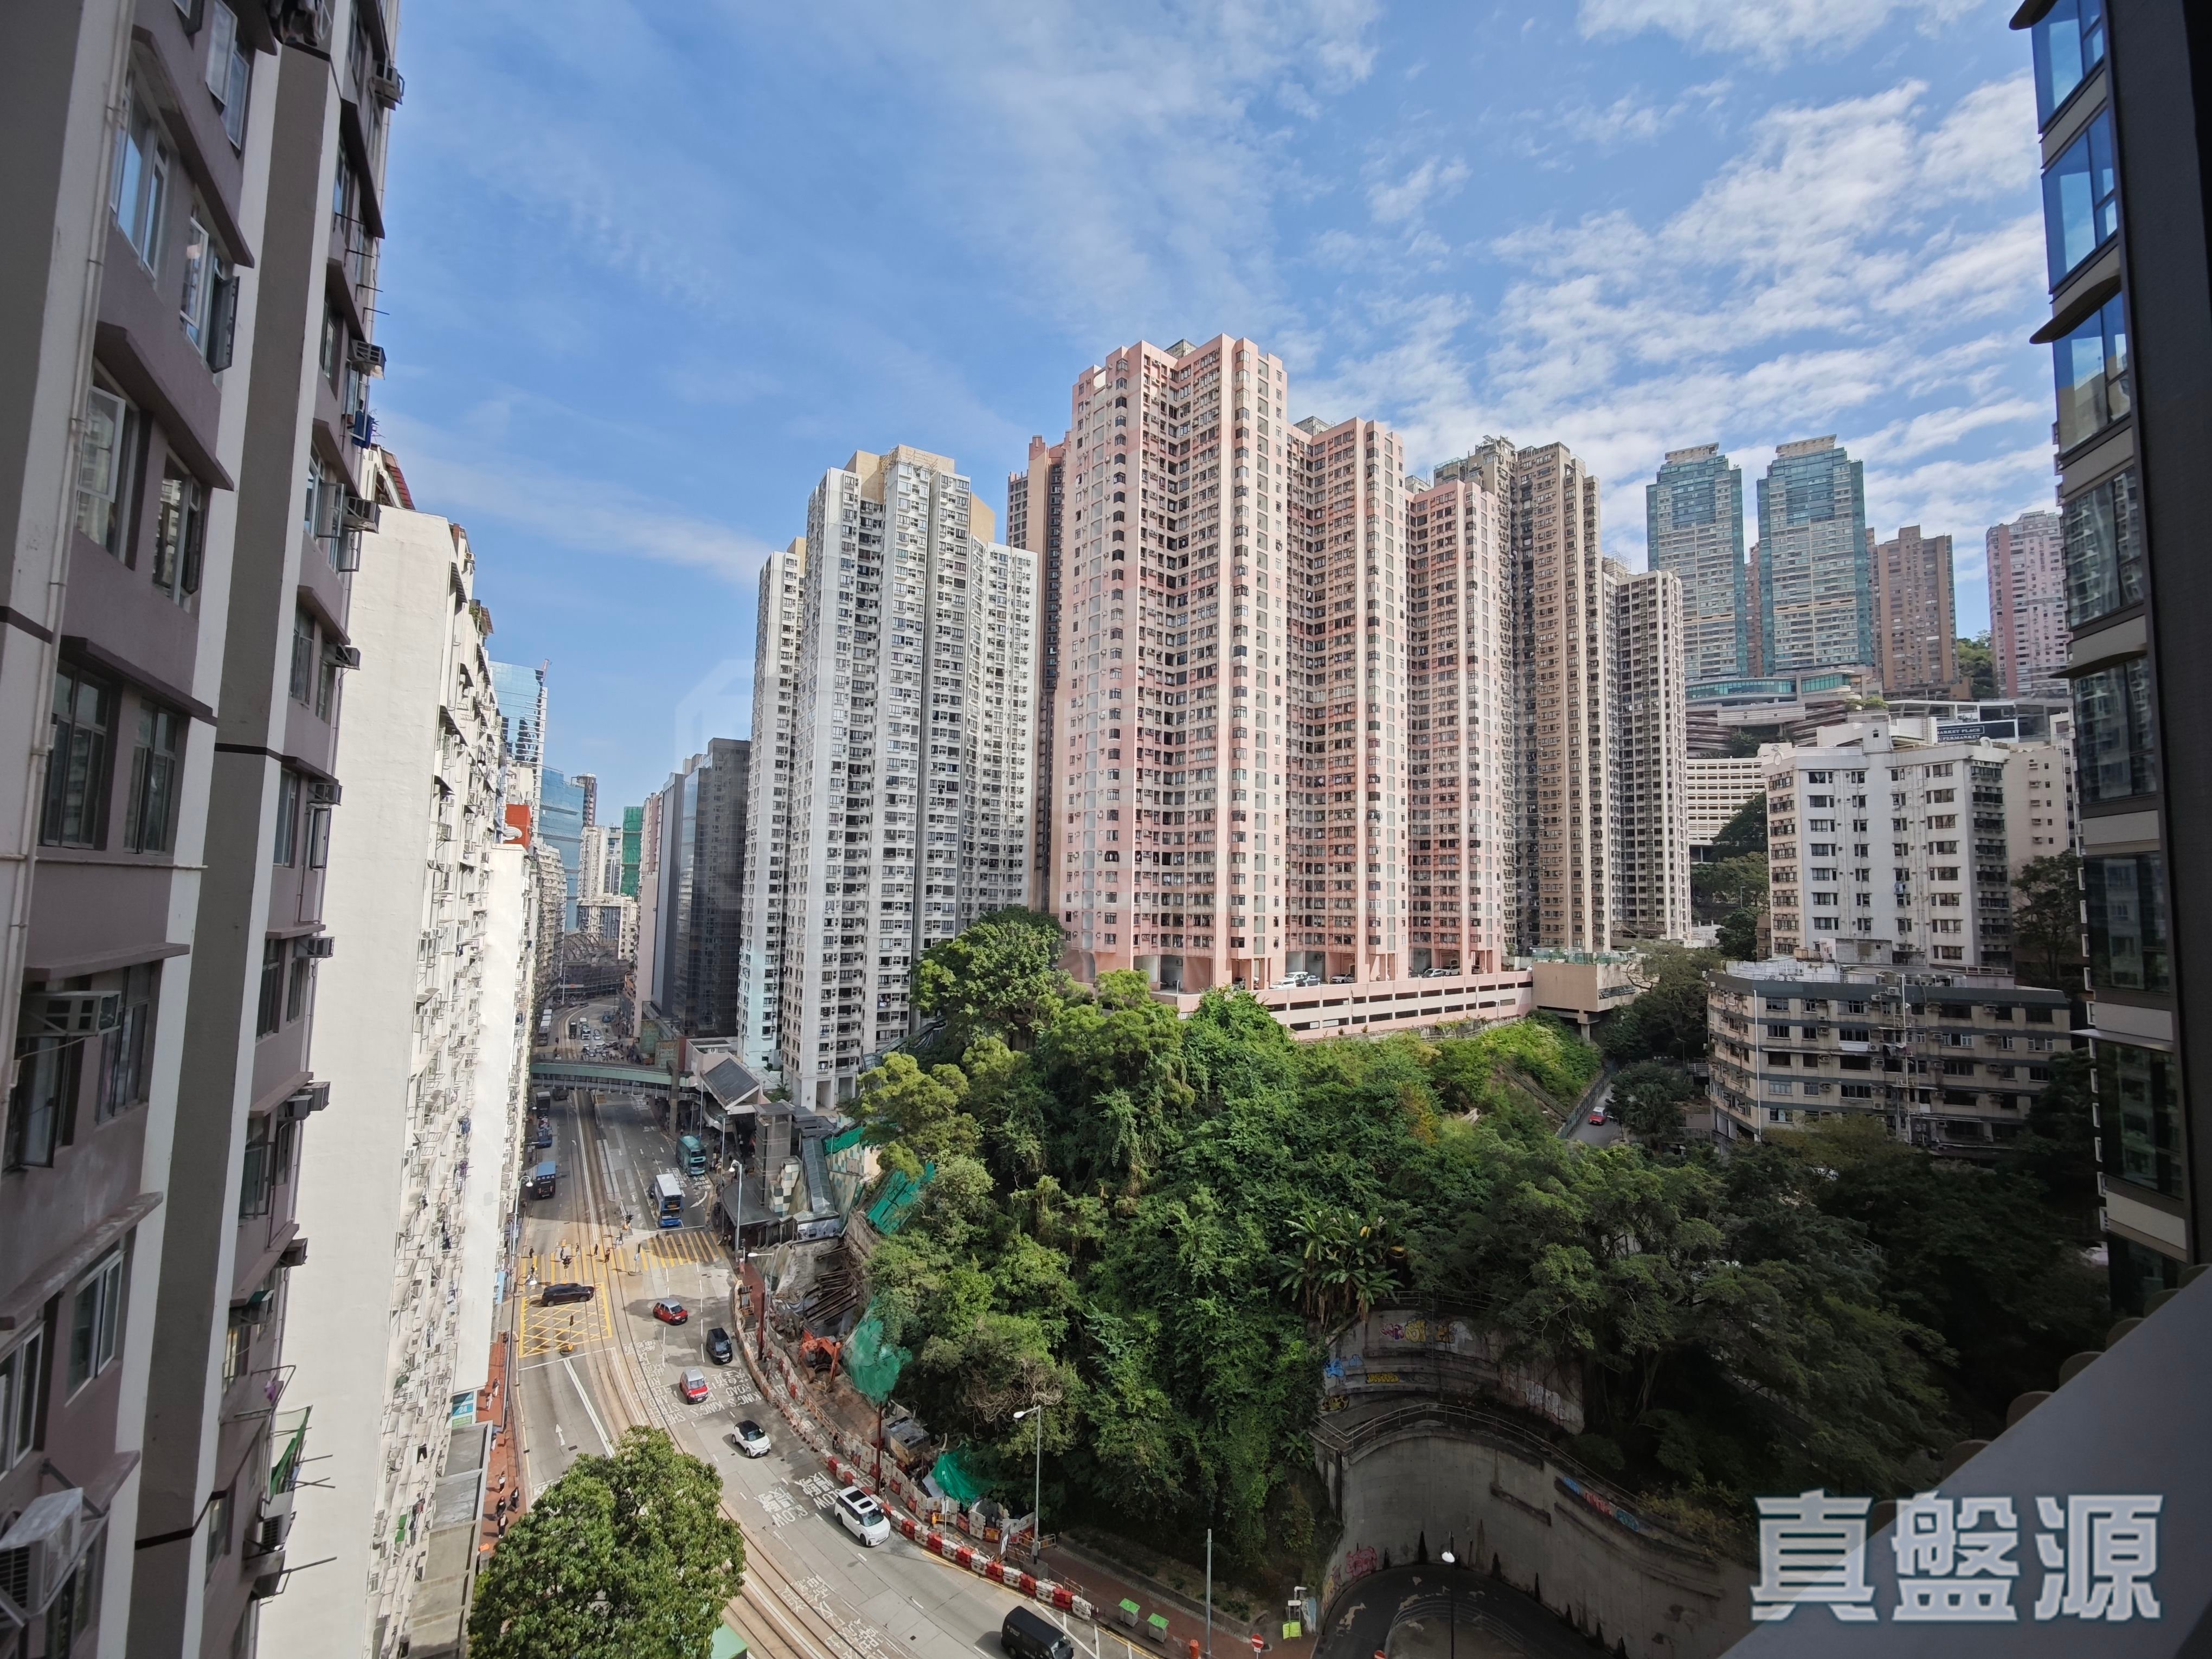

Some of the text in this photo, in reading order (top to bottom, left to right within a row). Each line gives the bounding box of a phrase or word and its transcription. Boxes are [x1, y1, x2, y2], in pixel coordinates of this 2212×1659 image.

[635, 1377, 661, 1391] ROAD
[711, 1368, 749, 1388] 英皇道
[726, 1383, 751, 1396] ROAD
[648, 1394, 668, 1408] AND
[728, 1392, 762, 1407] KING'S
[641, 1403, 680, 1420] STREET
[690, 1401, 725, 1417] KING'S
[651, 1411, 686, 1429] SHELL
[794, 1471, 835, 1497] 慢駛
[772, 1504, 808, 1528] SLOW
